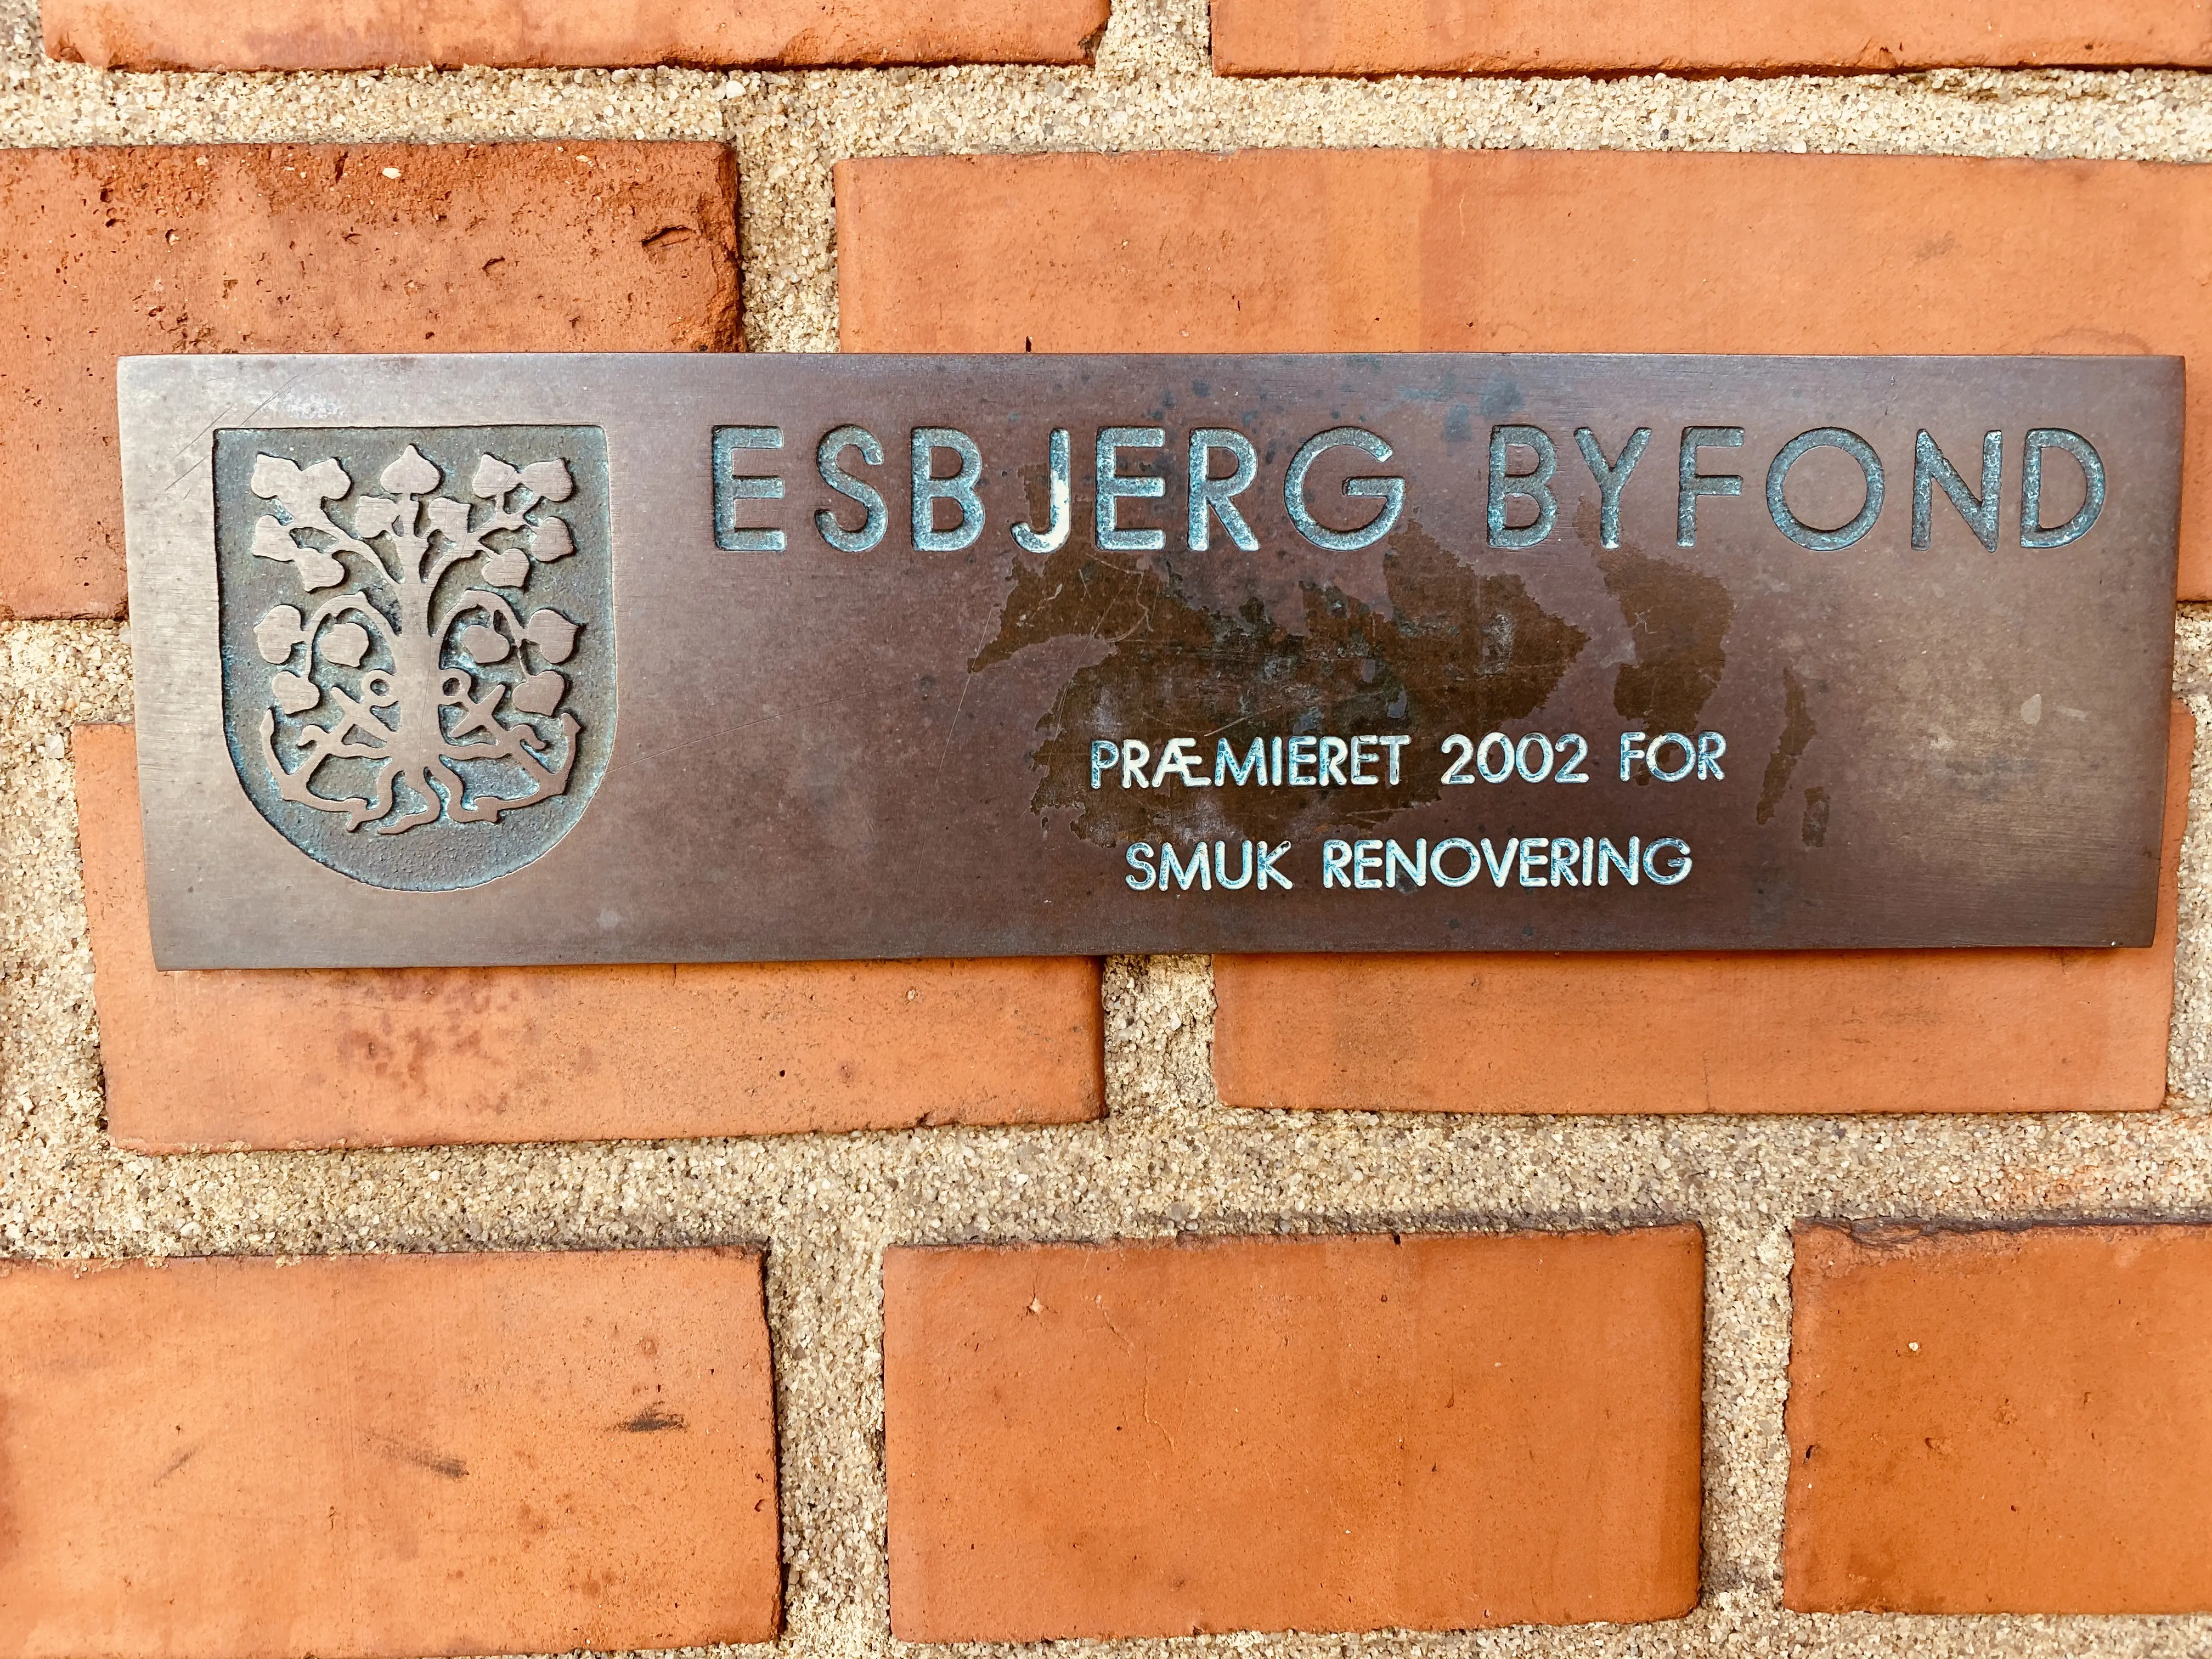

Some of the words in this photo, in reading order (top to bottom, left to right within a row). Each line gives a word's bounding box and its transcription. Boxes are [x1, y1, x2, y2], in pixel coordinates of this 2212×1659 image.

[714, 424, 1406, 553] ESBJERG
[1487, 425, 2106, 552] BYFOND
[1090, 735, 1412, 789] PRÆMIERET
[1441, 731, 1589, 785] 2002
[1620, 731, 1727, 783] FOR
[1125, 839, 1294, 892] SMUK
[1322, 836, 1693, 889] RENOVERING
